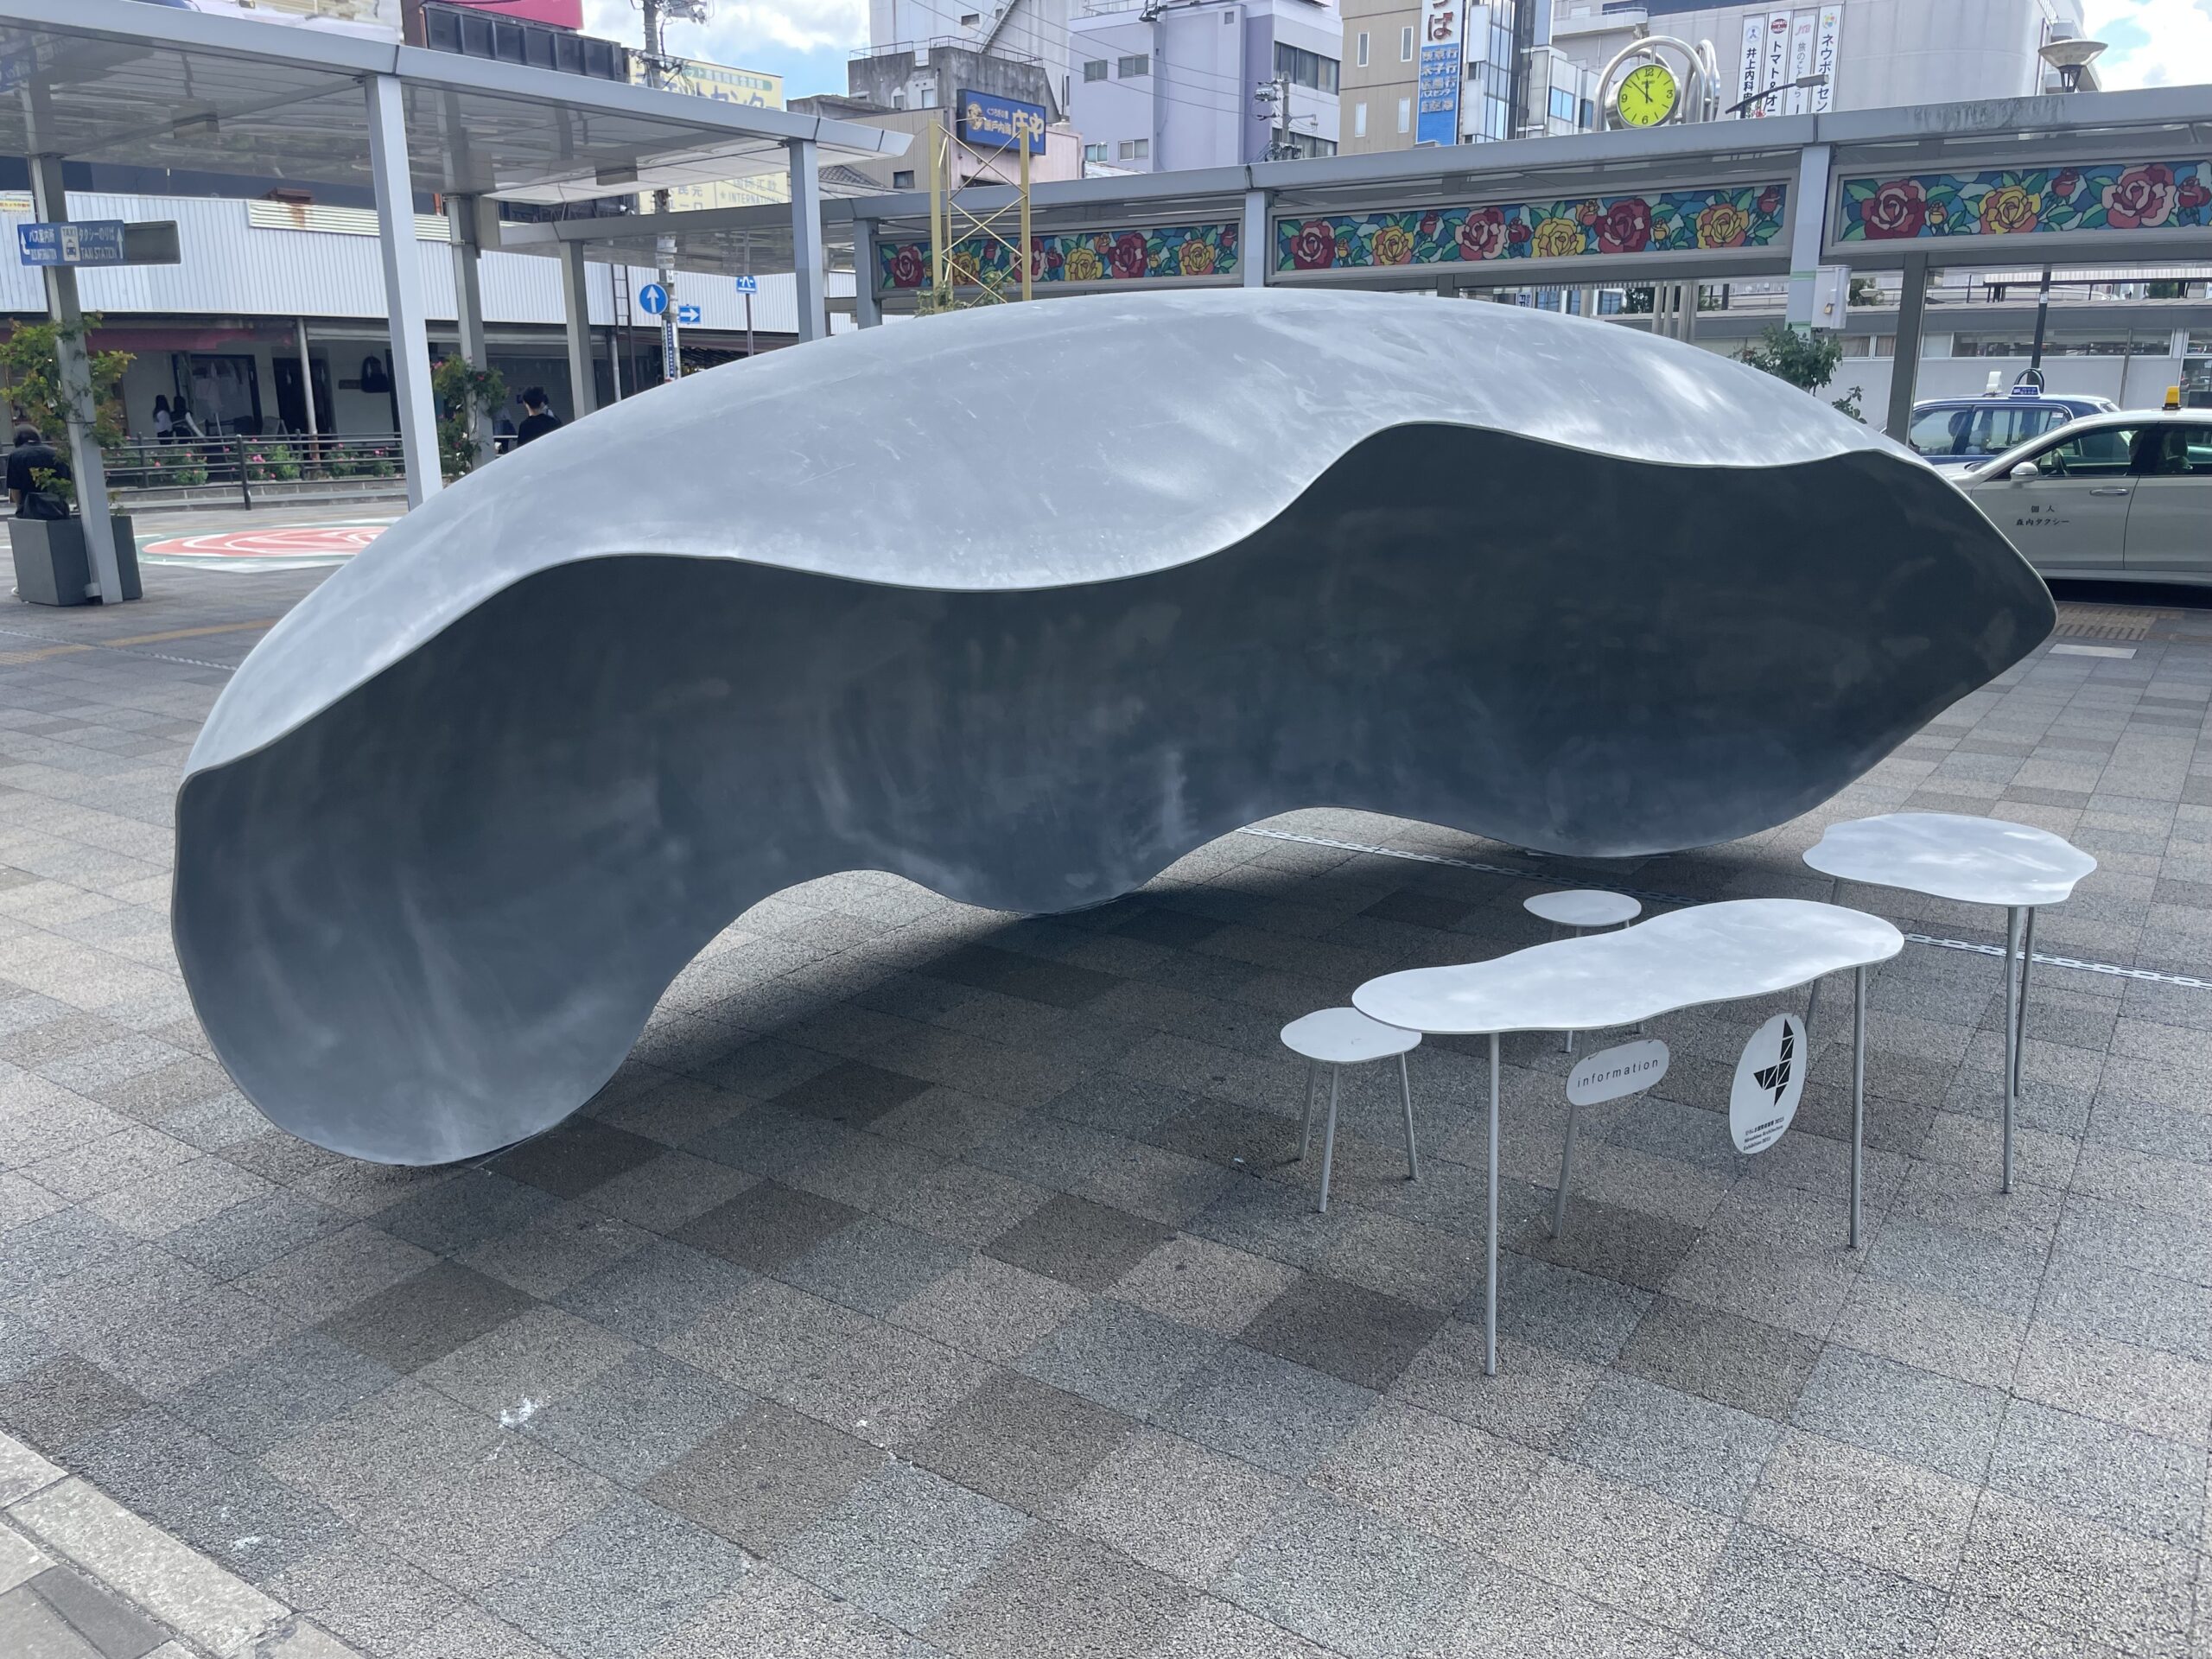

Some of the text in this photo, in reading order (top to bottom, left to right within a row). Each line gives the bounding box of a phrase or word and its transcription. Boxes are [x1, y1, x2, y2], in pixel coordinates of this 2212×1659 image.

[1796, 23, 1812, 35] JTB
[1644, 67, 1654, 77] 12
[1795, 42, 1807, 98] 旅のことら
[1815, 35, 1834, 111] ネウボセン
[1621, 93, 1628, 103] 9
[1666, 89, 1674, 99] 3
[1012, 109, 1045, 143] 庄や
[1642, 115, 1649, 124] 6
[670, 184, 703, 198] 民元
[62, 227, 77, 236] TAXI
[79, 226, 115, 242] タクシーのりば
[80, 246, 118, 260] TAXI STATION
[1577, 1058, 1659, 1088] information
